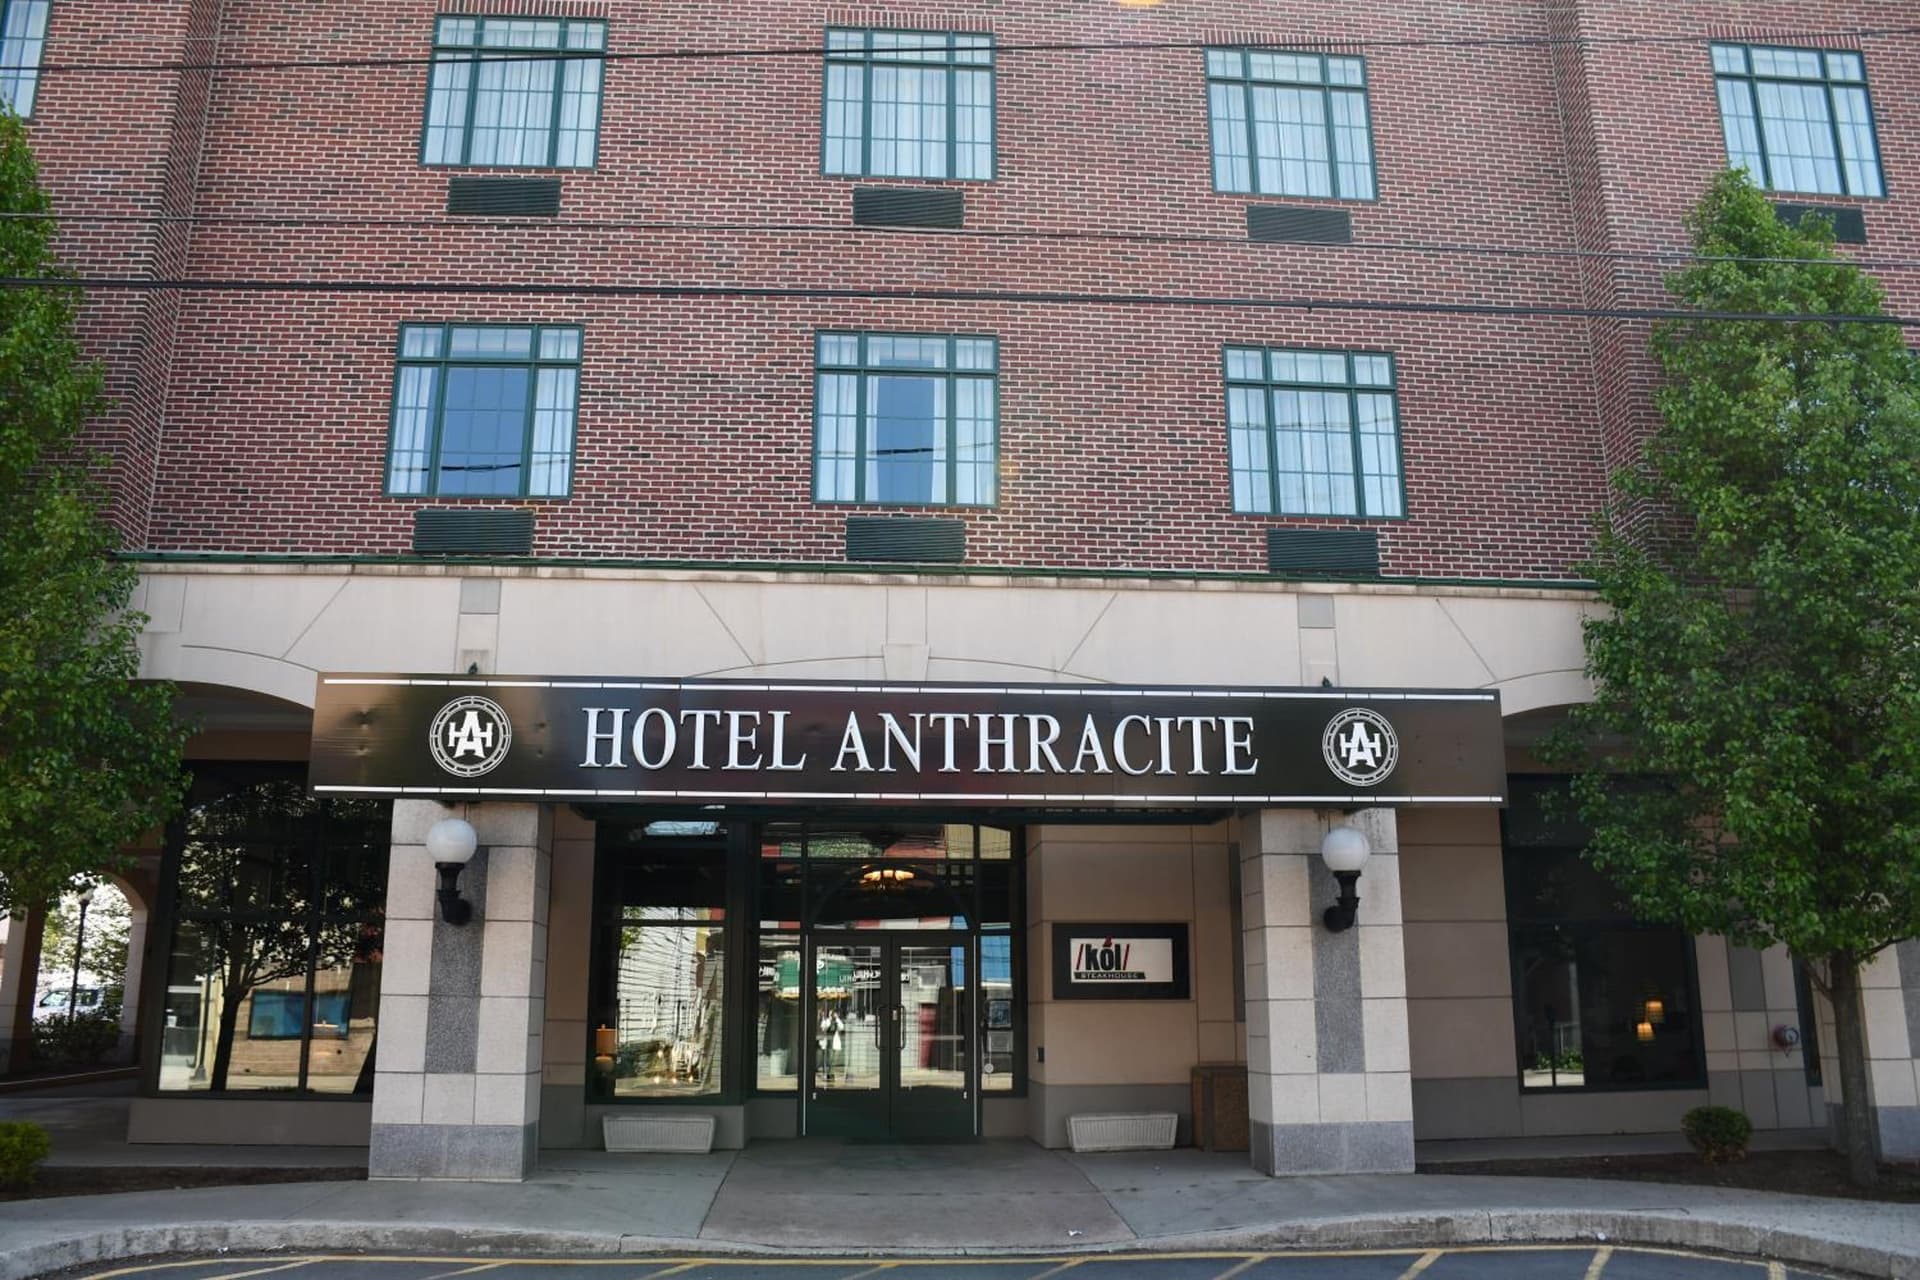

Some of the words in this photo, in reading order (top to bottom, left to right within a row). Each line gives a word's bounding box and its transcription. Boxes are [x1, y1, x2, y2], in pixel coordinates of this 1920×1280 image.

[579, 707, 807, 771] HOTEL
[829, 711, 1260, 775] ANTHRACITE
[1081, 972, 1138, 980] STEAKHOUSE
